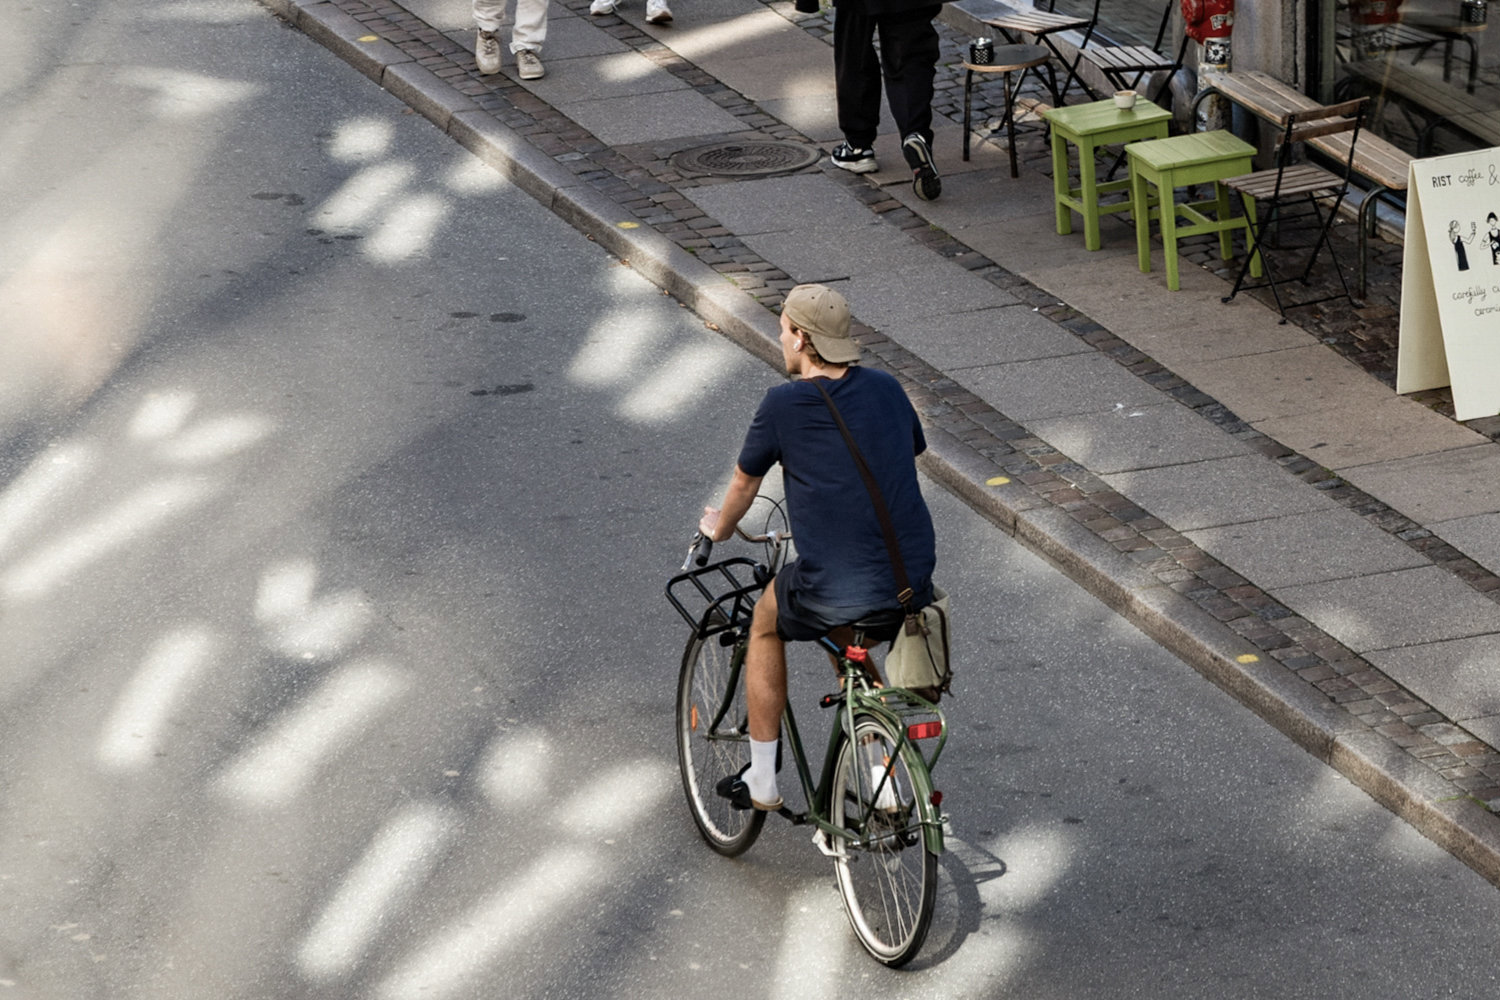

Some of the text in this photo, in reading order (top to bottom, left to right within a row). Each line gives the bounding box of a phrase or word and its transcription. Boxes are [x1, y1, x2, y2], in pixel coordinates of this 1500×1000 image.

[1432, 163, 1500, 188] RIST coffee &
[1452, 283, 1487, 304] carefully
